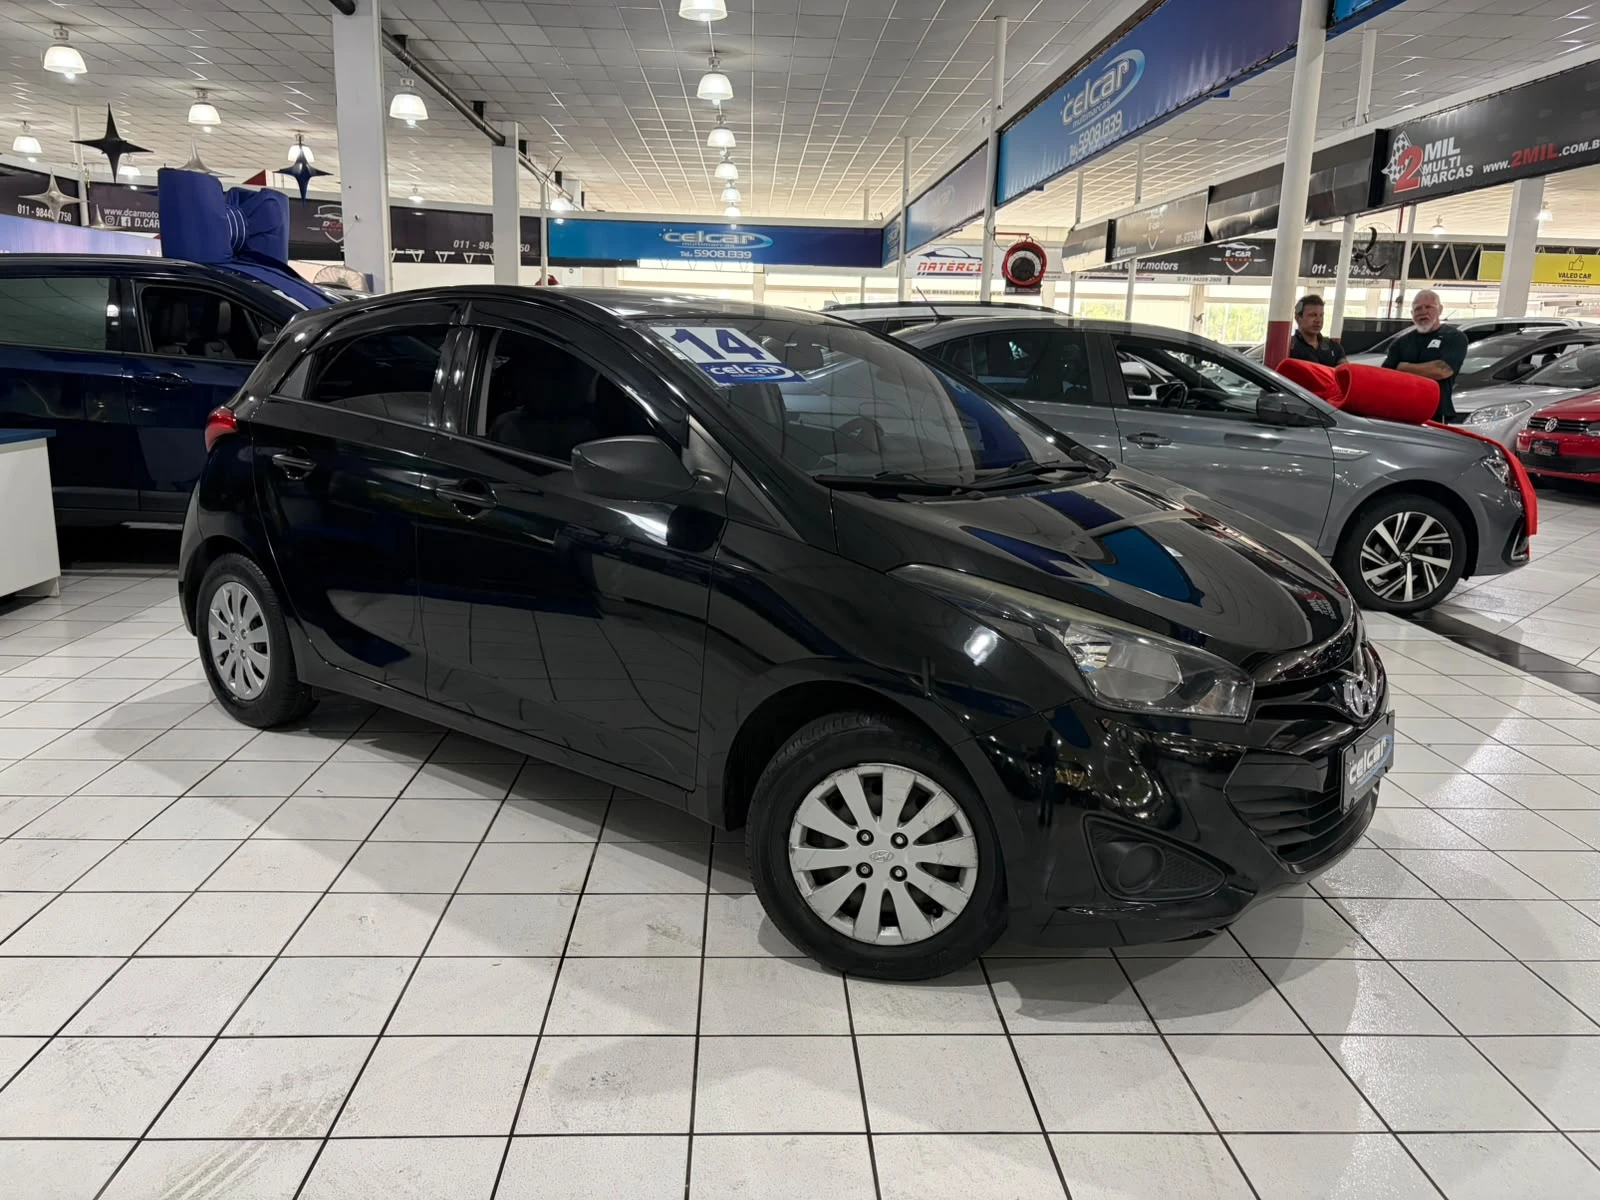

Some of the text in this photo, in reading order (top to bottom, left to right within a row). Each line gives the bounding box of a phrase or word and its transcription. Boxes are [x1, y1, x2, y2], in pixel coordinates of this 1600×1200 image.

[1063, 60, 1130, 125] celcar
[1393, 136, 1461, 193] 2 MIL
[1421, 155, 1461, 177] MULTI
[1420, 164, 1474, 188] MARCAS
[17, 203, 30, 215] 011
[453, 239, 470, 249] 011
[663, 231, 755, 245] celcar
[918, 260, 992, 272] NATÉRCI
[1124, 261, 1179, 271] ear.motors
[1311, 264, 1327, 275] 011
[670, 328, 767, 361] 14
[710, 364, 779, 375] celcar
[1349, 738, 1388, 785] celcar
